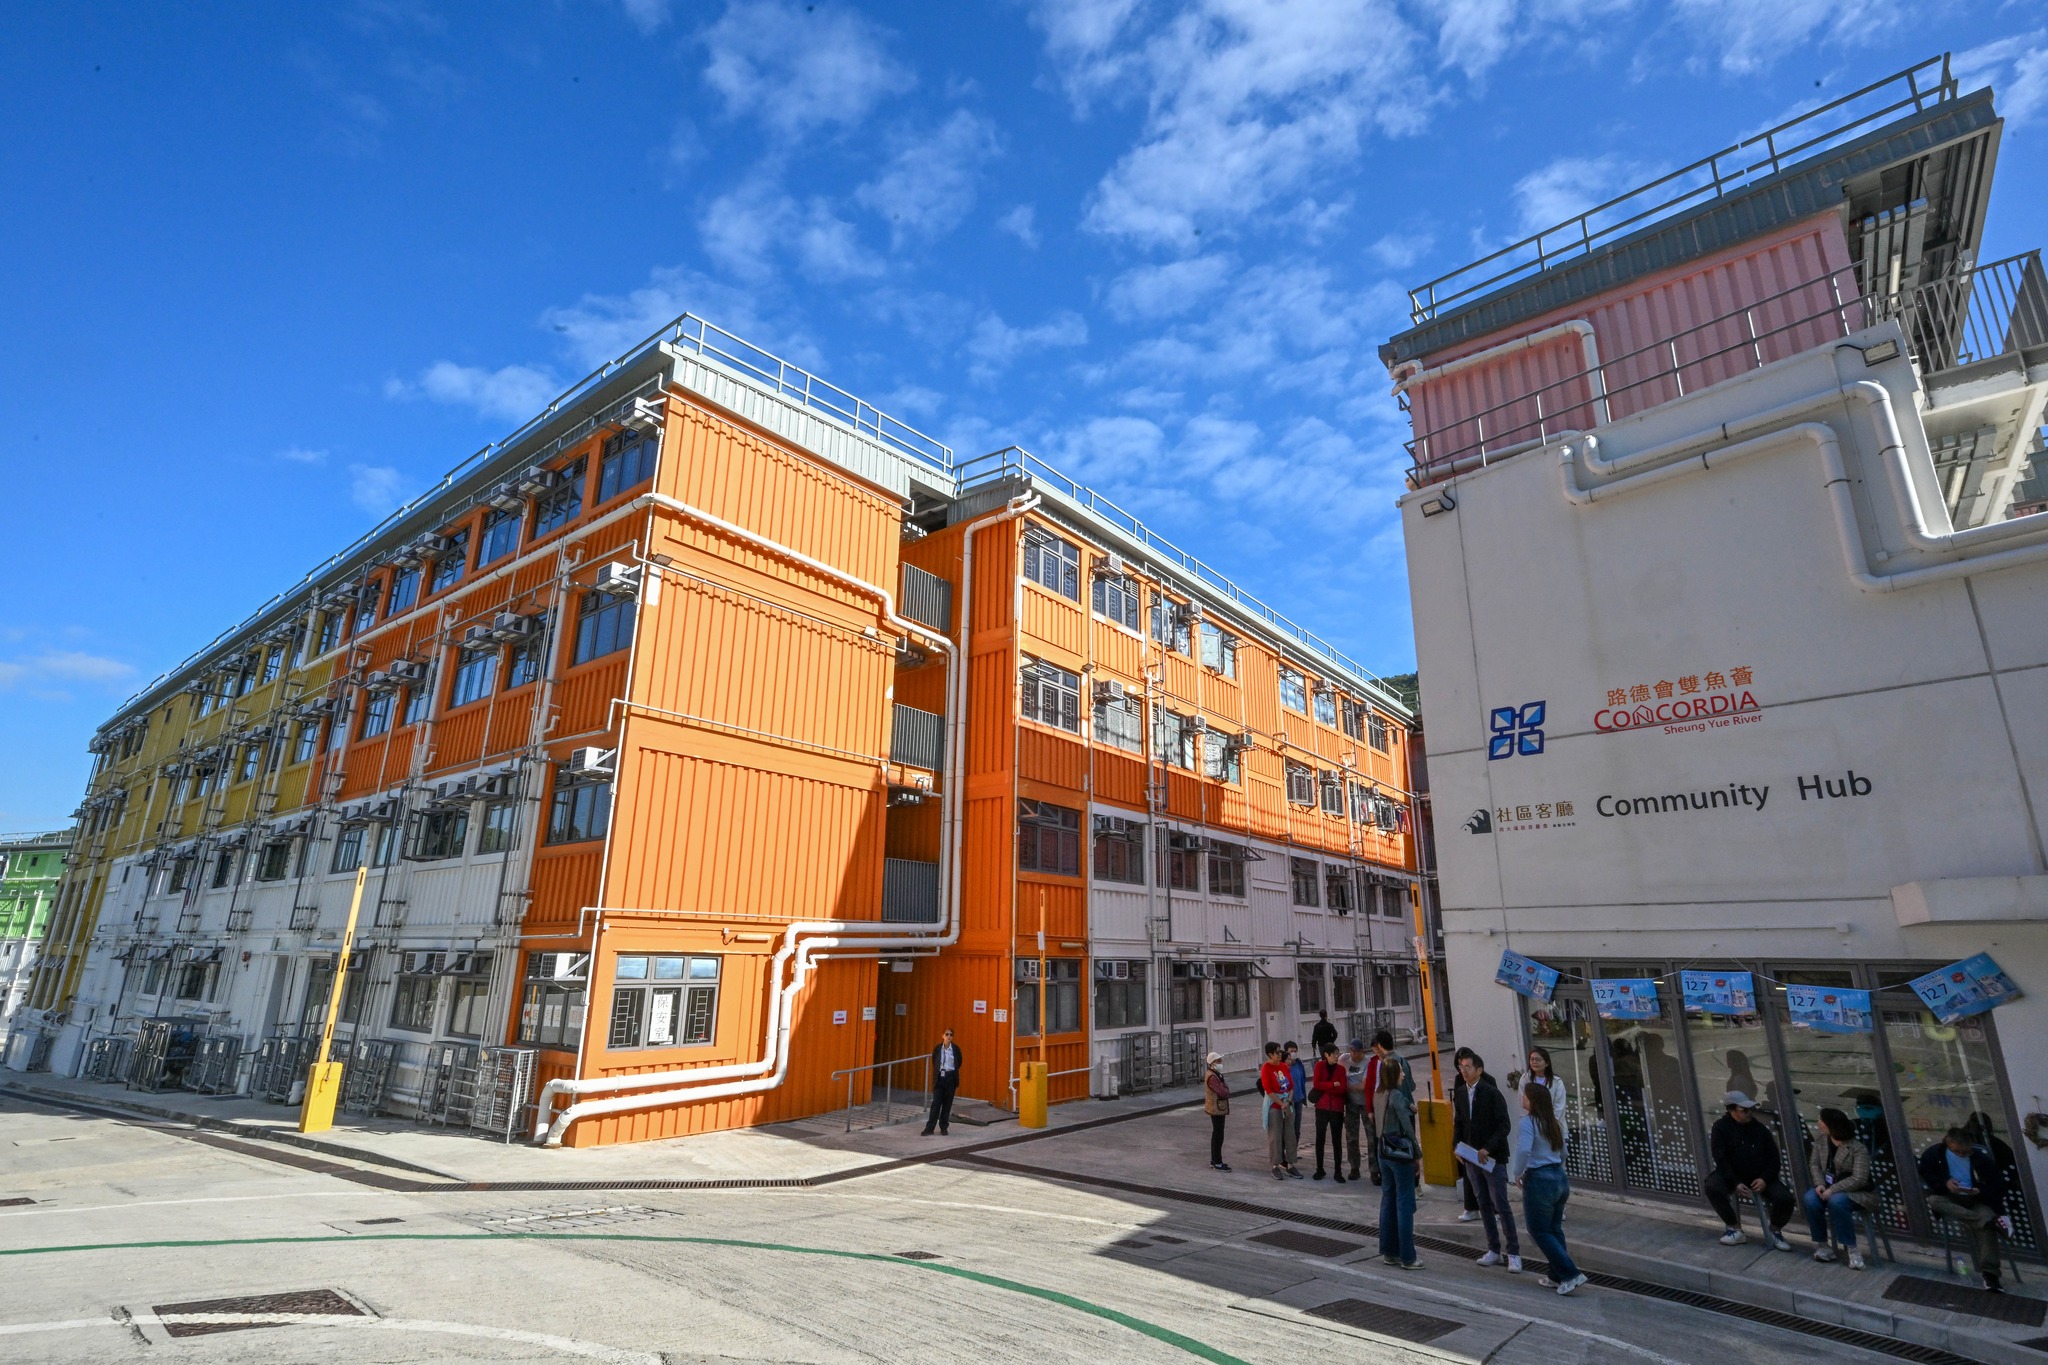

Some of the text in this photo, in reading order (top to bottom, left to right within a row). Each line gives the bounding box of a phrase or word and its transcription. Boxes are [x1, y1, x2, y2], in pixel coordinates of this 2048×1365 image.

[1607, 666, 1753, 707] 路德會雙魚薈
[1593, 691, 1759, 730] CONCORDIA
[1664, 713, 1763, 735] Sheung Yue River
[1496, 801, 1575, 823] 社區客廳
[1596, 770, 1873, 817] Community Hub
[654, 996, 669, 1040] 保安室
